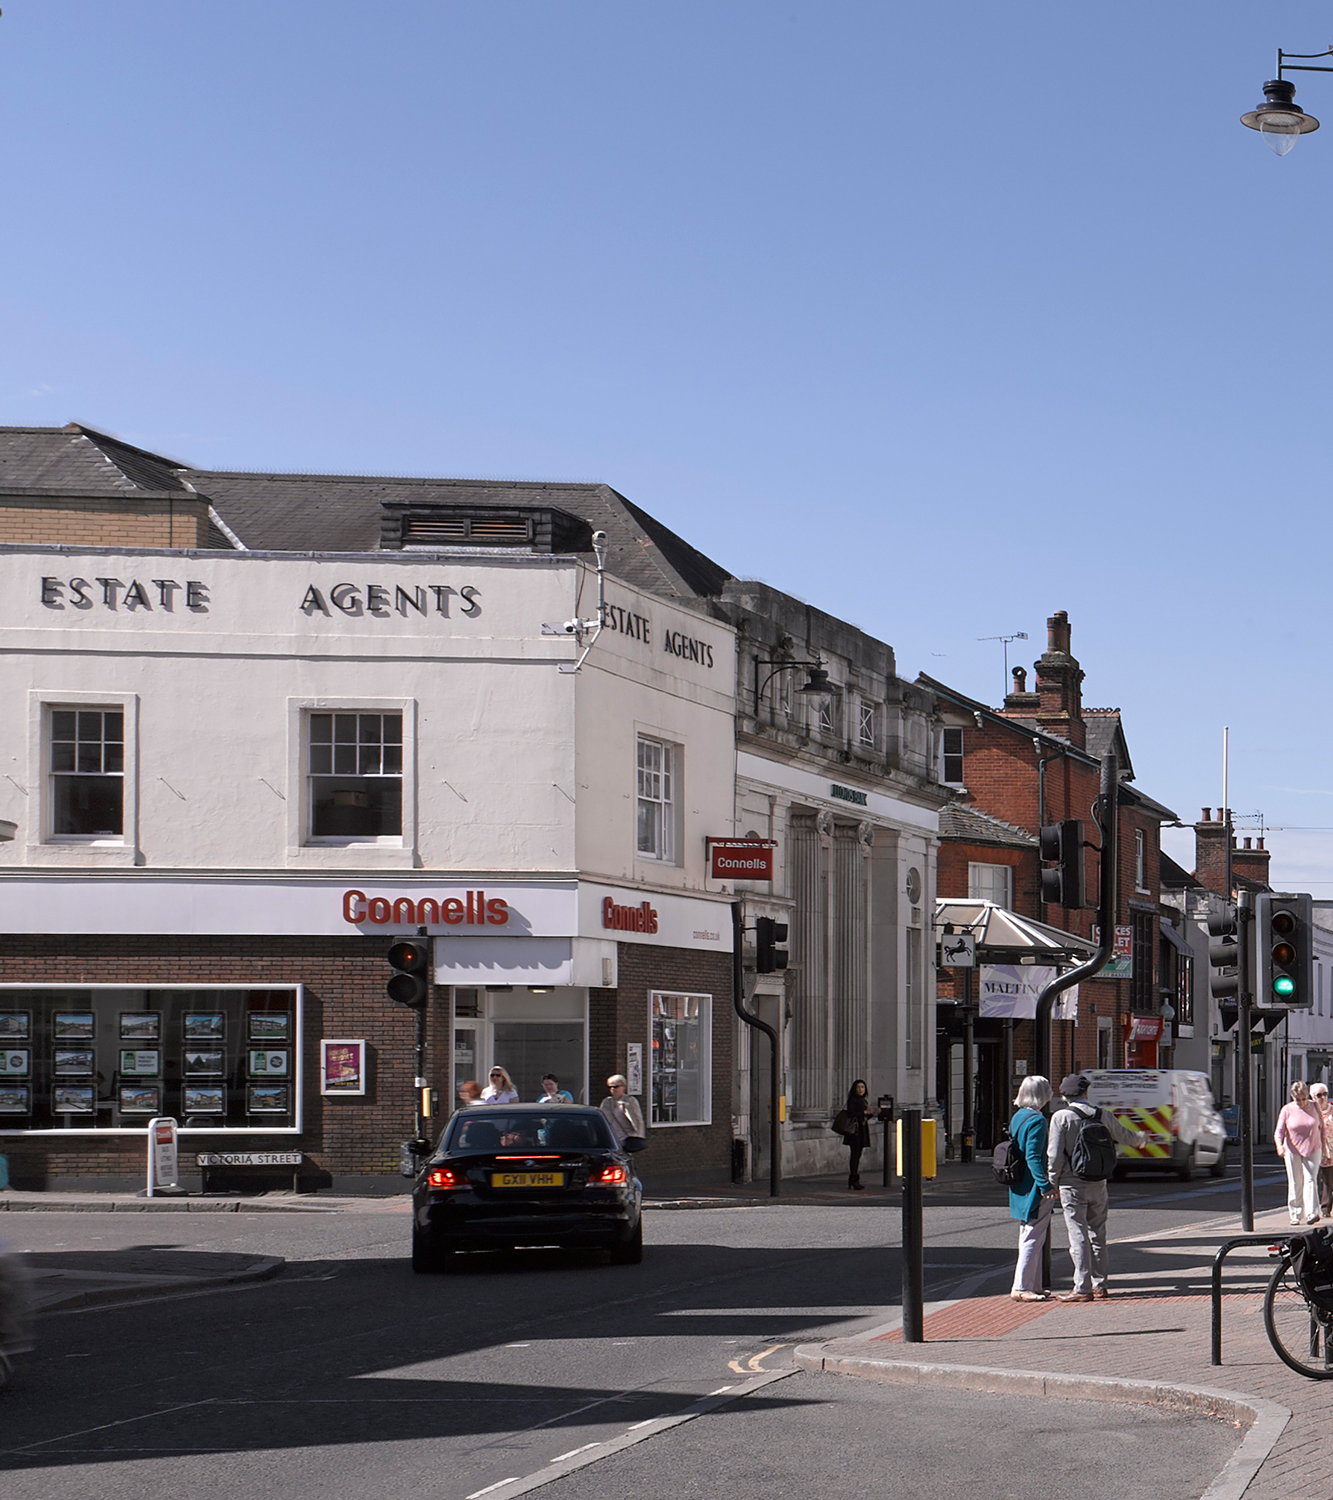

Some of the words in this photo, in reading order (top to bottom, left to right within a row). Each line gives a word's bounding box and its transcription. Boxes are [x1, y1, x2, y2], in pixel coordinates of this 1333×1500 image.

[41, 576, 204, 608] ESTATE
[300, 582, 478, 614] AGENTS
[601, 602, 650, 644] ESTATE
[664, 629, 714, 668] AGENTS
[717, 857, 767, 869] Connells
[343, 889, 509, 926] Connells
[603, 896, 658, 934] Connells
[200, 1155, 253, 1165] VICTORIA
[258, 1154, 299, 1163] STREET
[529, 1173, 554, 1184] VHH
